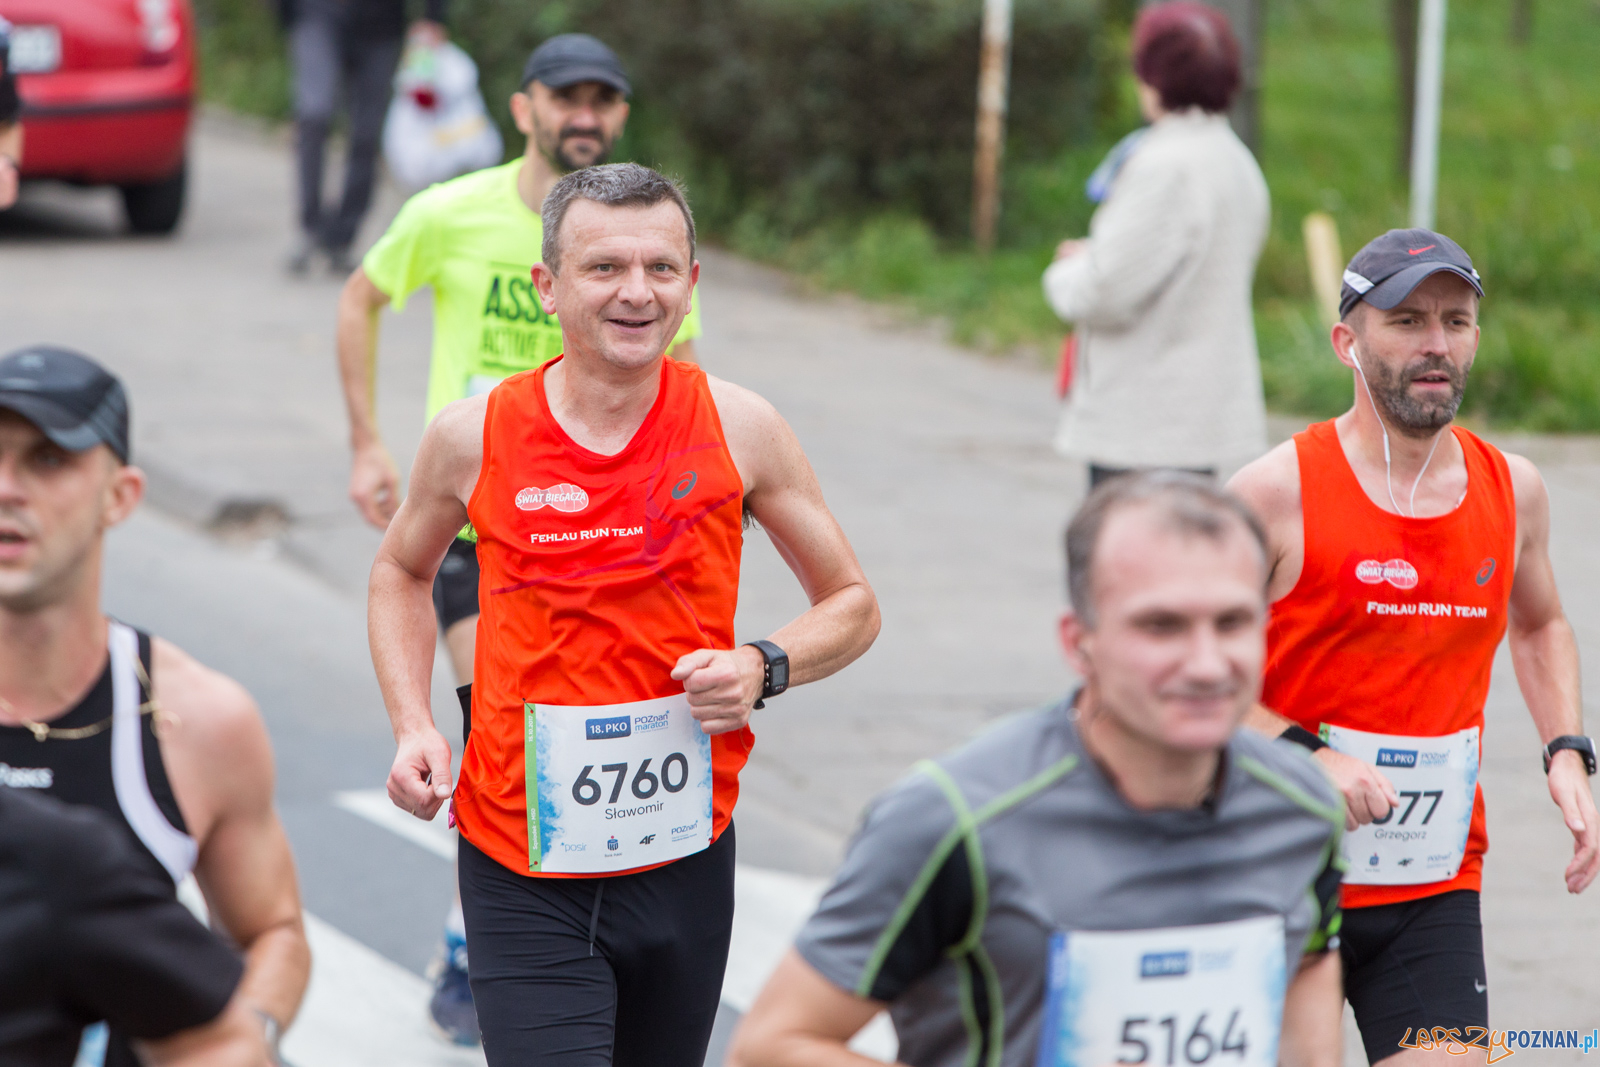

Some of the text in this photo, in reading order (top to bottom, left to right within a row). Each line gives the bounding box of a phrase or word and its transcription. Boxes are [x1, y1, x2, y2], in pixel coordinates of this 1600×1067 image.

[484, 275, 556, 326] ASS
[517, 492, 586, 504] ŚWIAT BIEGACZA
[530, 526, 644, 544] FEHLAU RUN TEAM
[1418, 602, 1452, 617] RUN
[1454, 605, 1487, 618] TEAM
[605, 722, 628, 733] PKO
[635, 720, 669, 731] maraton
[1394, 753, 1415, 765] PKO
[571, 752, 689, 806] 6760
[604, 800, 664, 820] Sławomir
[1374, 829, 1427, 842] Grzegorz
[1116, 1009, 1247, 1067] 5164
